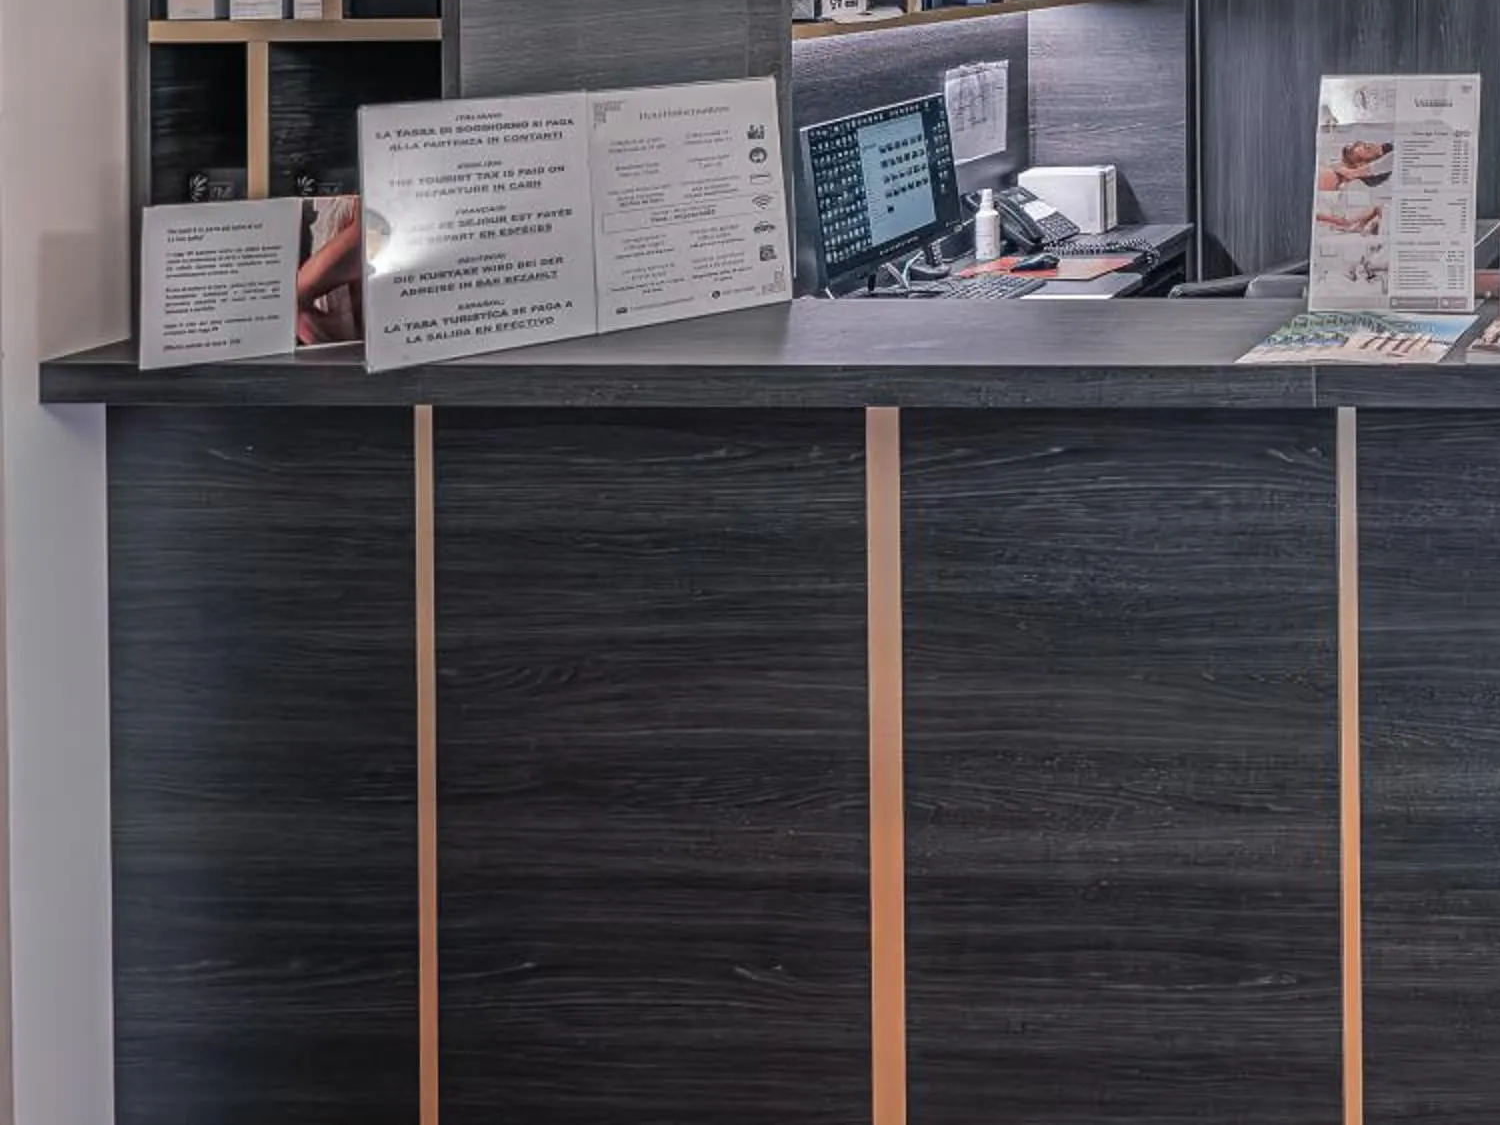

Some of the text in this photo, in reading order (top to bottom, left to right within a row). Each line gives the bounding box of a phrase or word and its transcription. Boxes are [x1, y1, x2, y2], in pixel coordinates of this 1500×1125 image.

[476, 172, 500, 181] TAX
[503, 169, 515, 179] IS
[548, 164, 566, 174] ON
[493, 183, 506, 192] IN
[475, 325, 493, 337] EN
